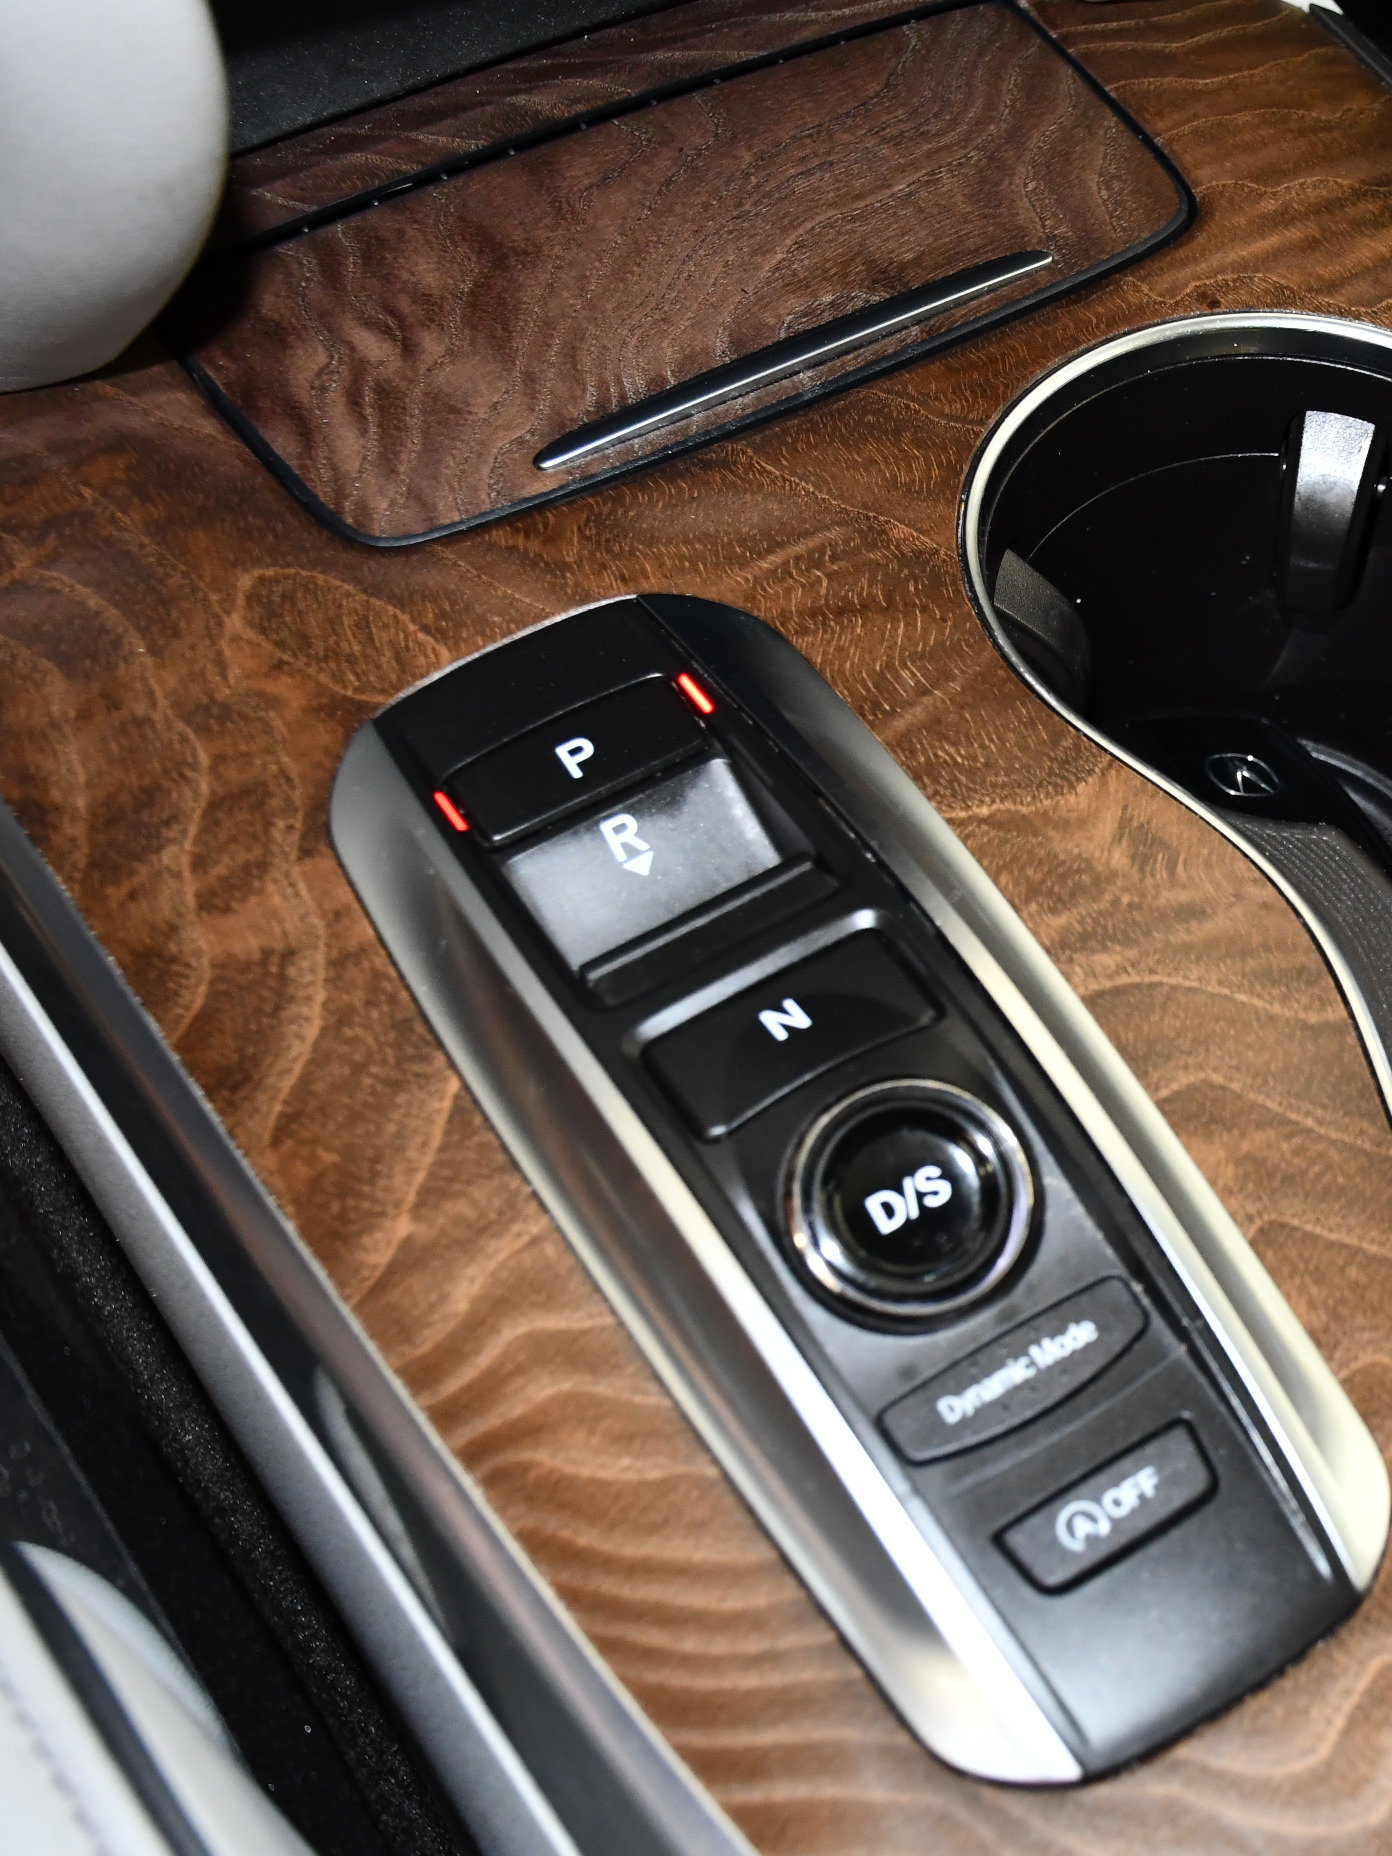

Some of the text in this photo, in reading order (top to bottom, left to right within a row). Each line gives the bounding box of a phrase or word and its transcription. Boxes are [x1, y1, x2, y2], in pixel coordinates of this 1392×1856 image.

[554, 737, 594, 778] P
[600, 813, 650, 862] R
[758, 998, 812, 1042] N
[864, 1164, 953, 1235] D/S
[936, 1318, 1099, 1425] Dynamic Mode
[1104, 1466, 1160, 1518] OFF
